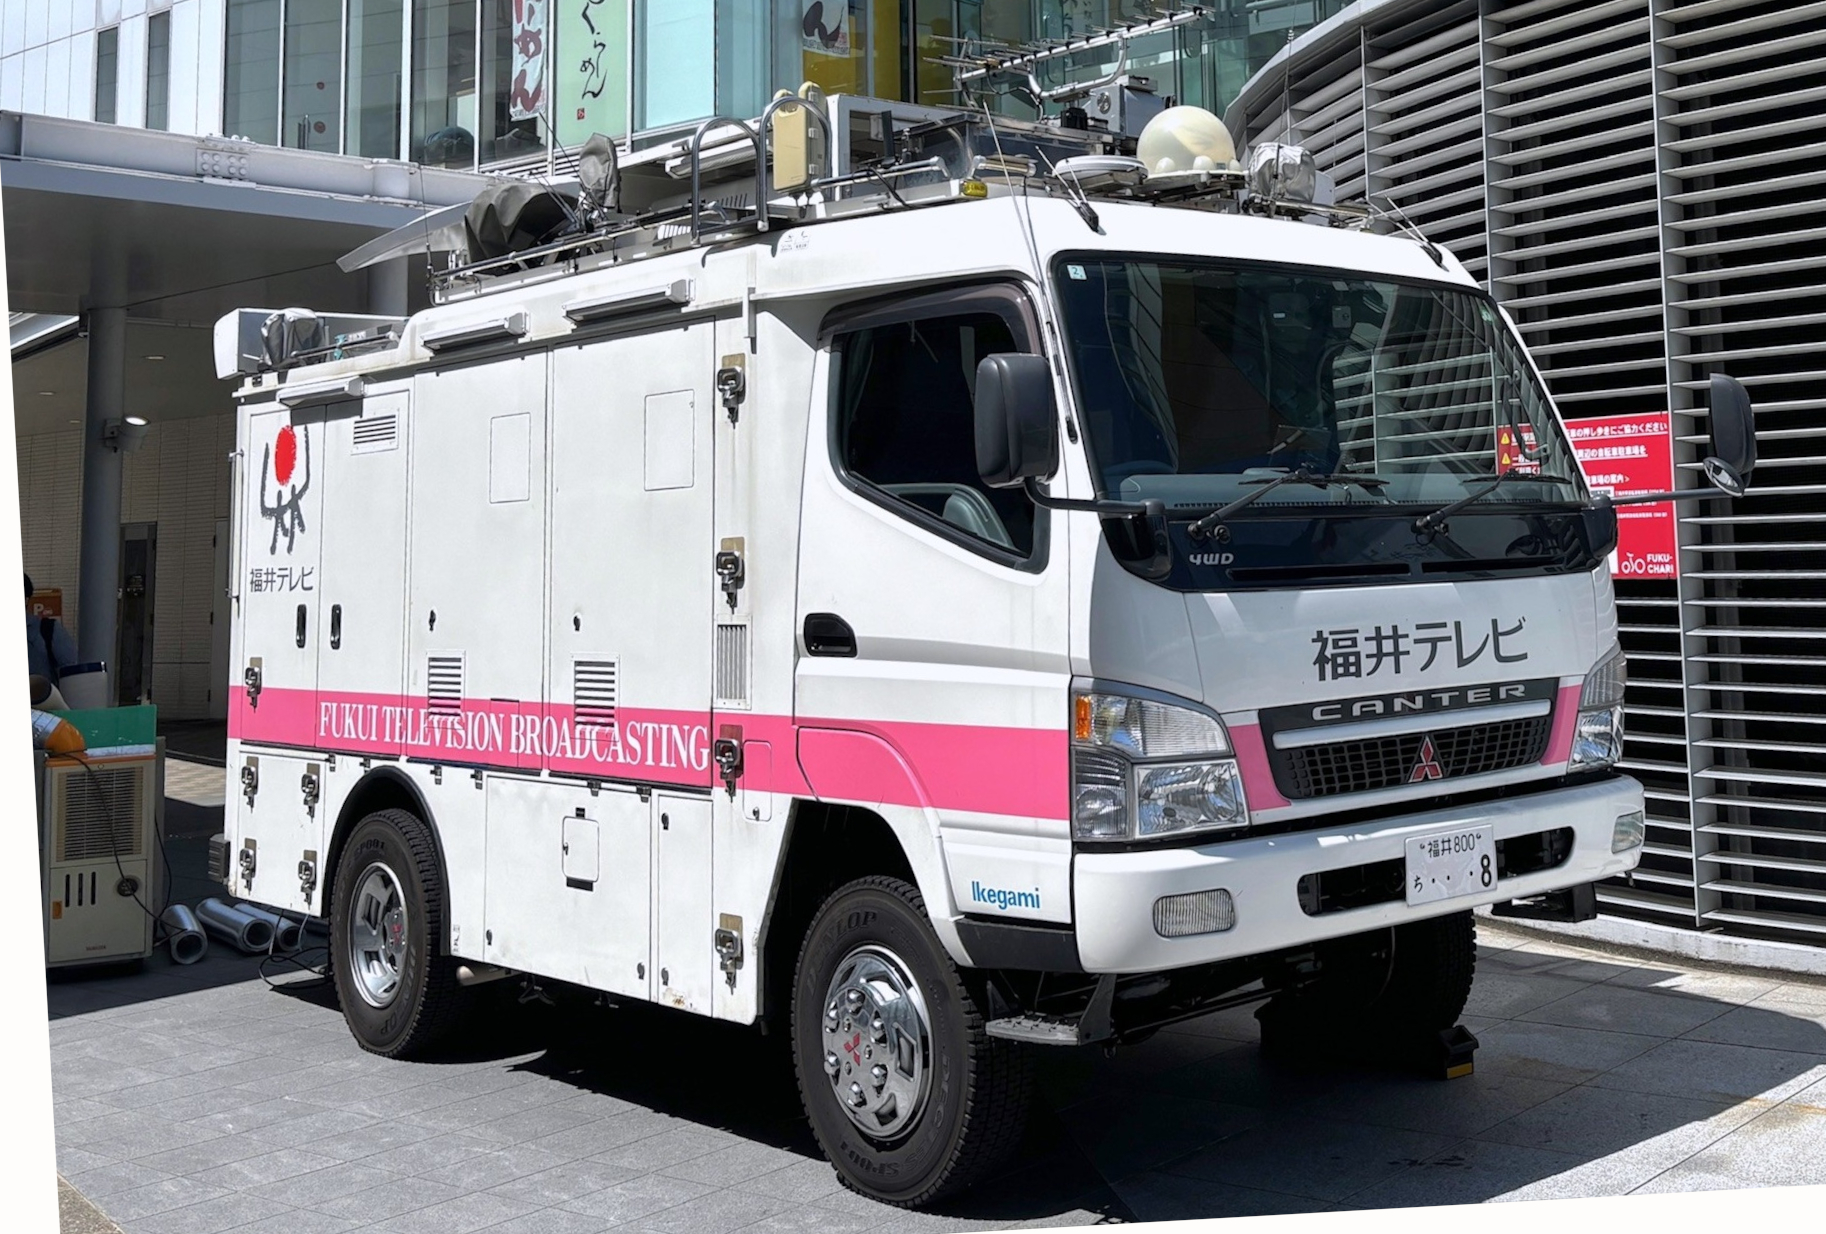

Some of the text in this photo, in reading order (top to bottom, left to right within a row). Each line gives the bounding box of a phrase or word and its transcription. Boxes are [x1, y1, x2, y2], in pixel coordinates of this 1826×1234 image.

[1189, 552, 1234, 566] 4WD
[1646, 553, 1673, 563] FUKU-
[1647, 563, 1674, 574] CHARI
[249, 566, 314, 593] 福井テレビ
[1311, 616, 1529, 681] 福井テレビ
[1312, 683, 1527, 721] CANTER
[319, 701, 711, 771] FUKUI TELEVISION BROADCASTING
[971, 880, 1041, 909] Ikegami
